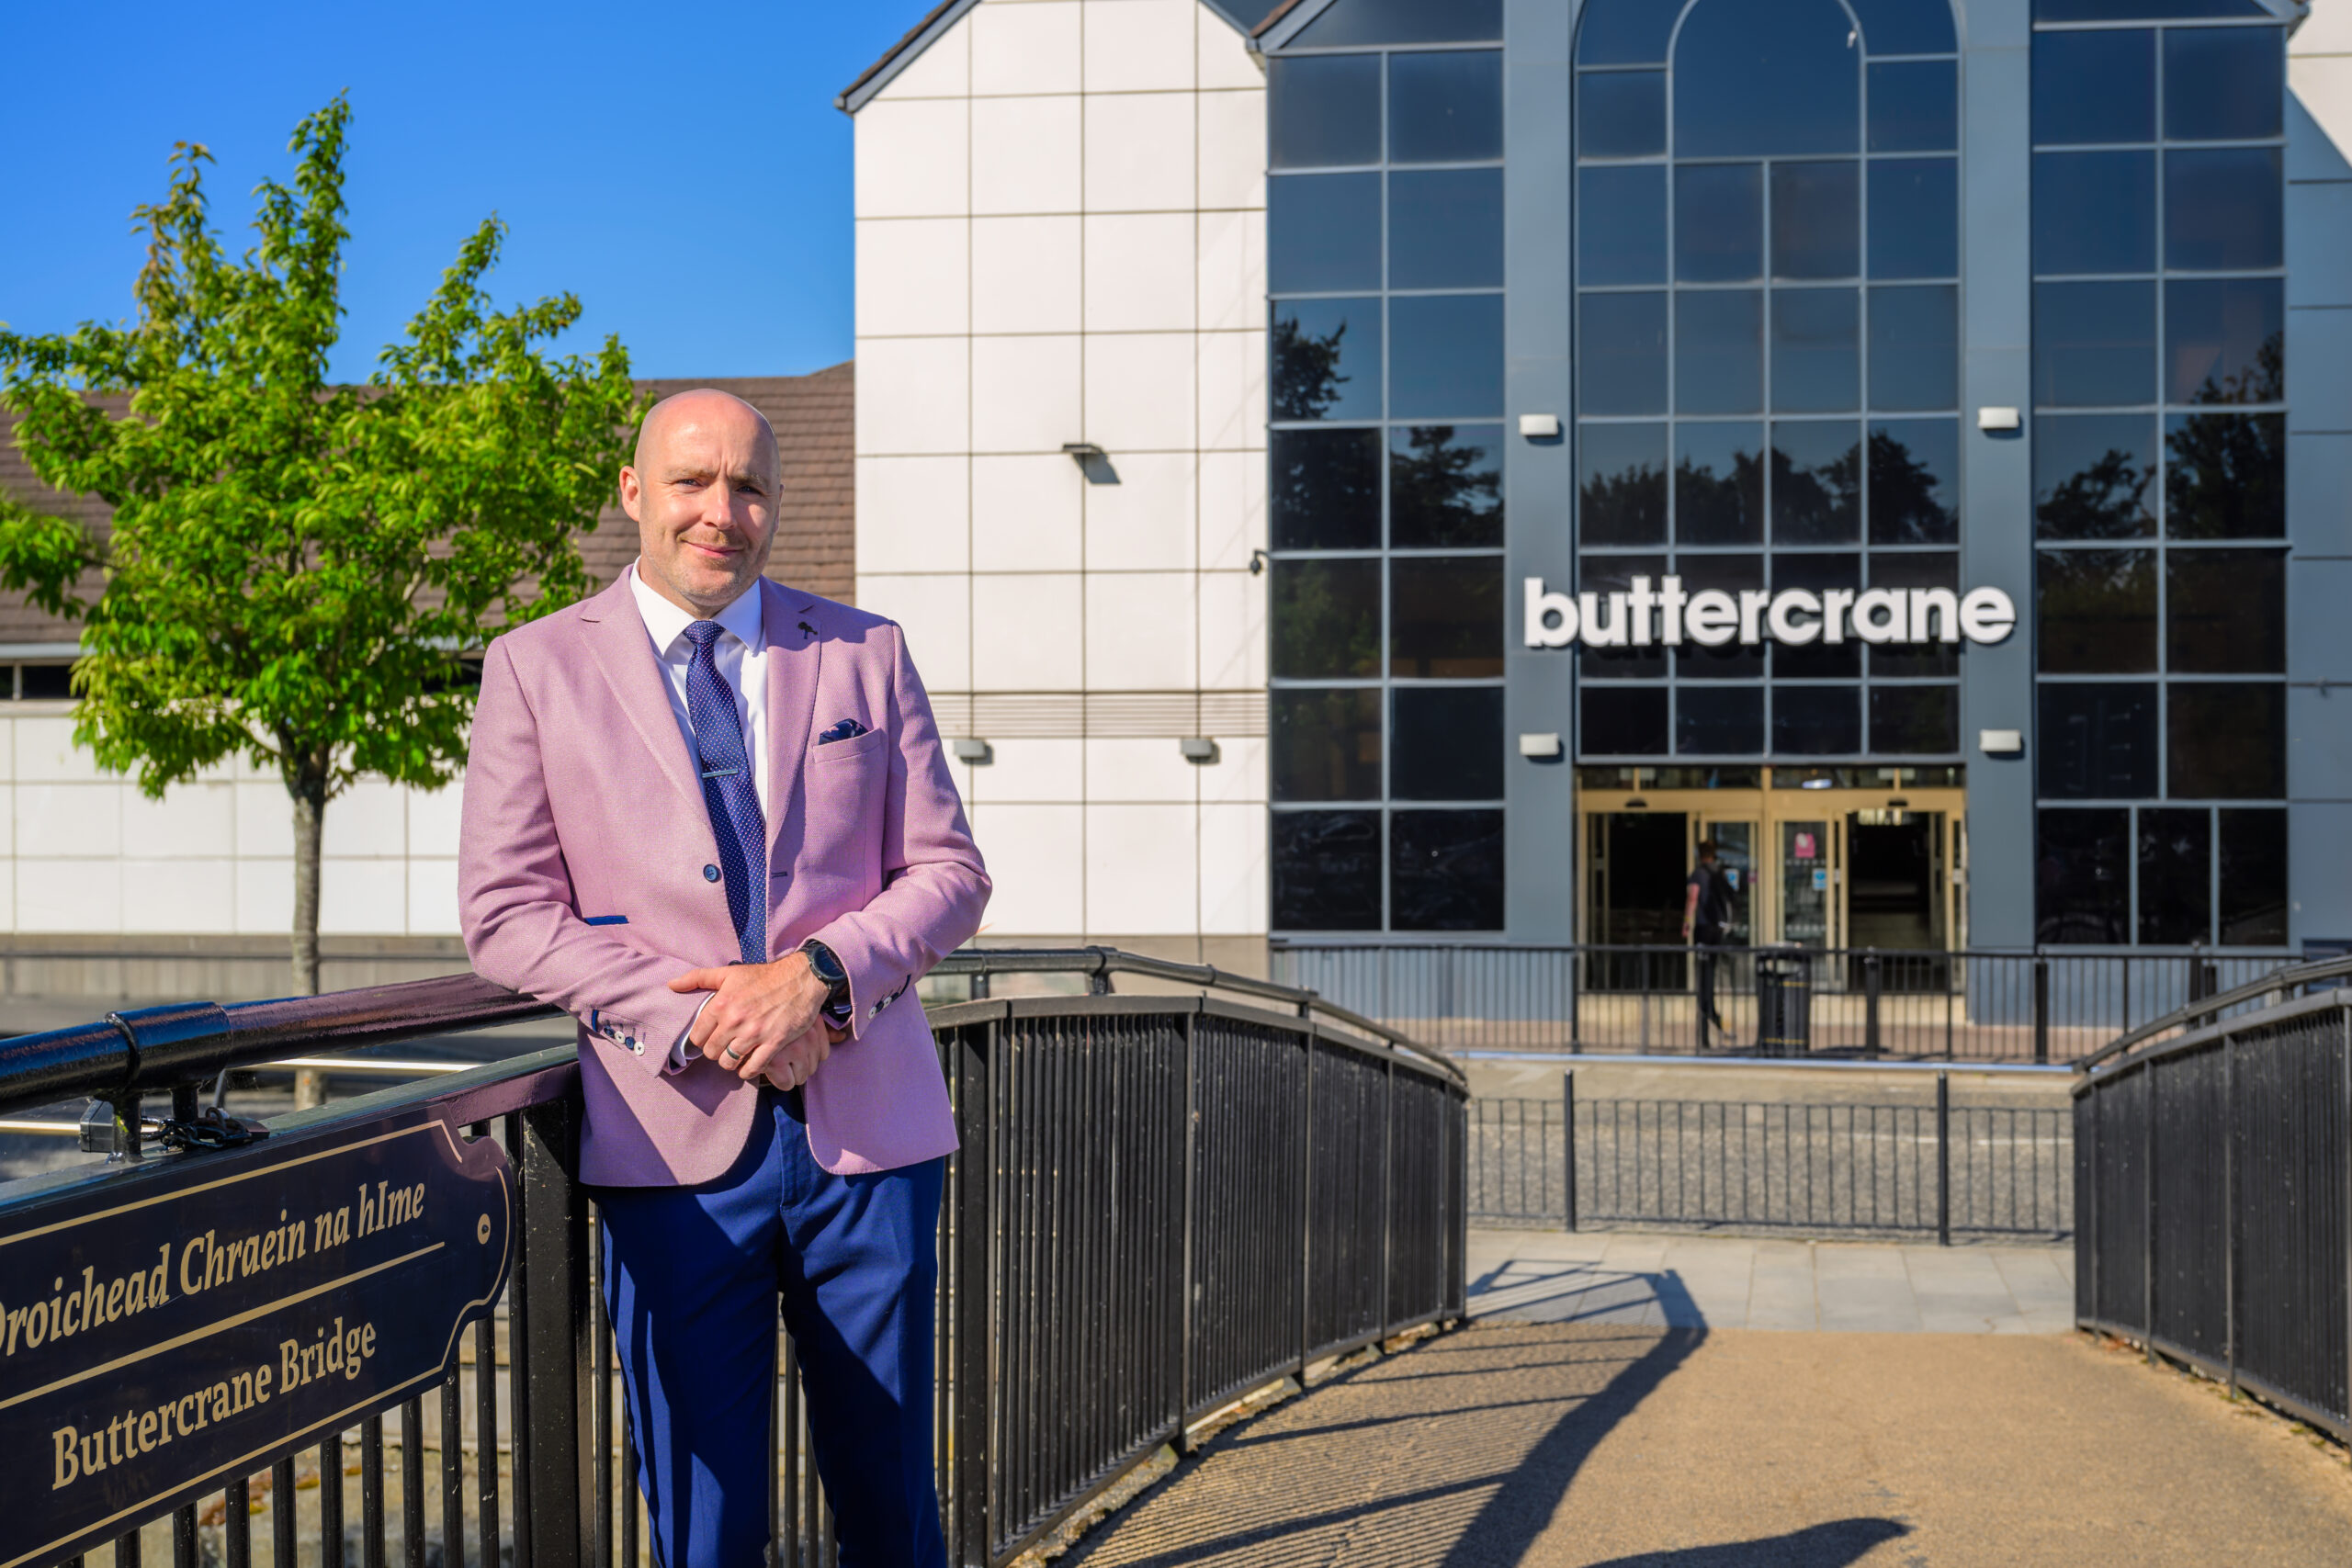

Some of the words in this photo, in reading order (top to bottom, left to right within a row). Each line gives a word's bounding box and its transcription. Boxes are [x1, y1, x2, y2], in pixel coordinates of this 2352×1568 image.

[1524, 576, 2015, 646] buttercrane
[0, 1243, 171, 1357] roichead
[181, 1210, 306, 1295] Chraein
[315, 1212, 350, 1253] na
[358, 1181, 424, 1238] hIme
[52, 1365, 272, 1491] Buttercrane
[280, 1317, 376, 1394] Bridge
